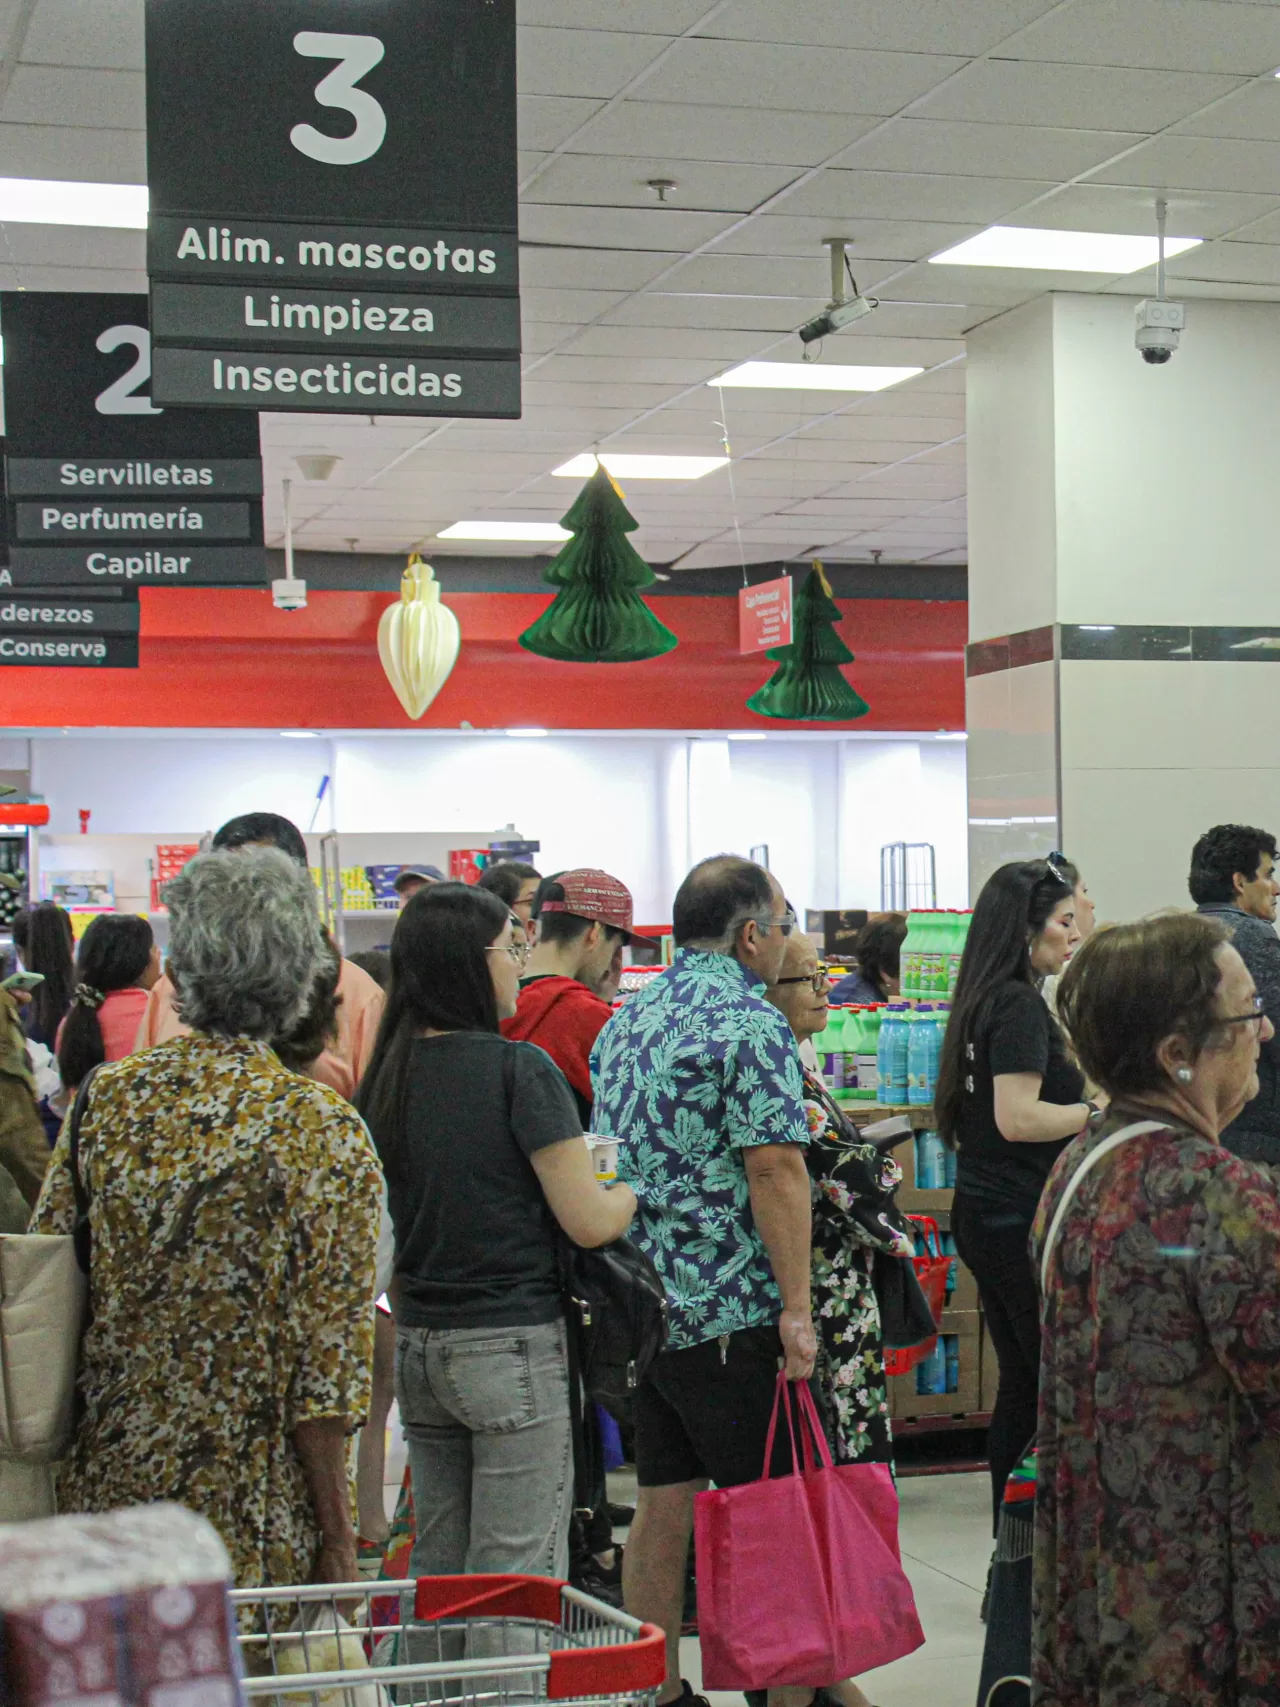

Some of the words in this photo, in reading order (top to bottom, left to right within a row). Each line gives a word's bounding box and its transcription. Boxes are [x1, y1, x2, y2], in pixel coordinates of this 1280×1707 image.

[289, 31, 388, 166] 3
[177, 226, 285, 265] Alim.
[299, 240, 497, 274] mascotas
[244, 295, 435, 336] Limpieza
[95, 324, 164, 415] 2
[213, 358, 463, 398] Insecticidas
[60, 462, 213, 486] Servilletas
[42, 506, 203, 530] Perfumería
[86, 552, 192, 579] Capilar
[0, 603, 94, 623] derezos
[0, 638, 106, 658] Conserva
